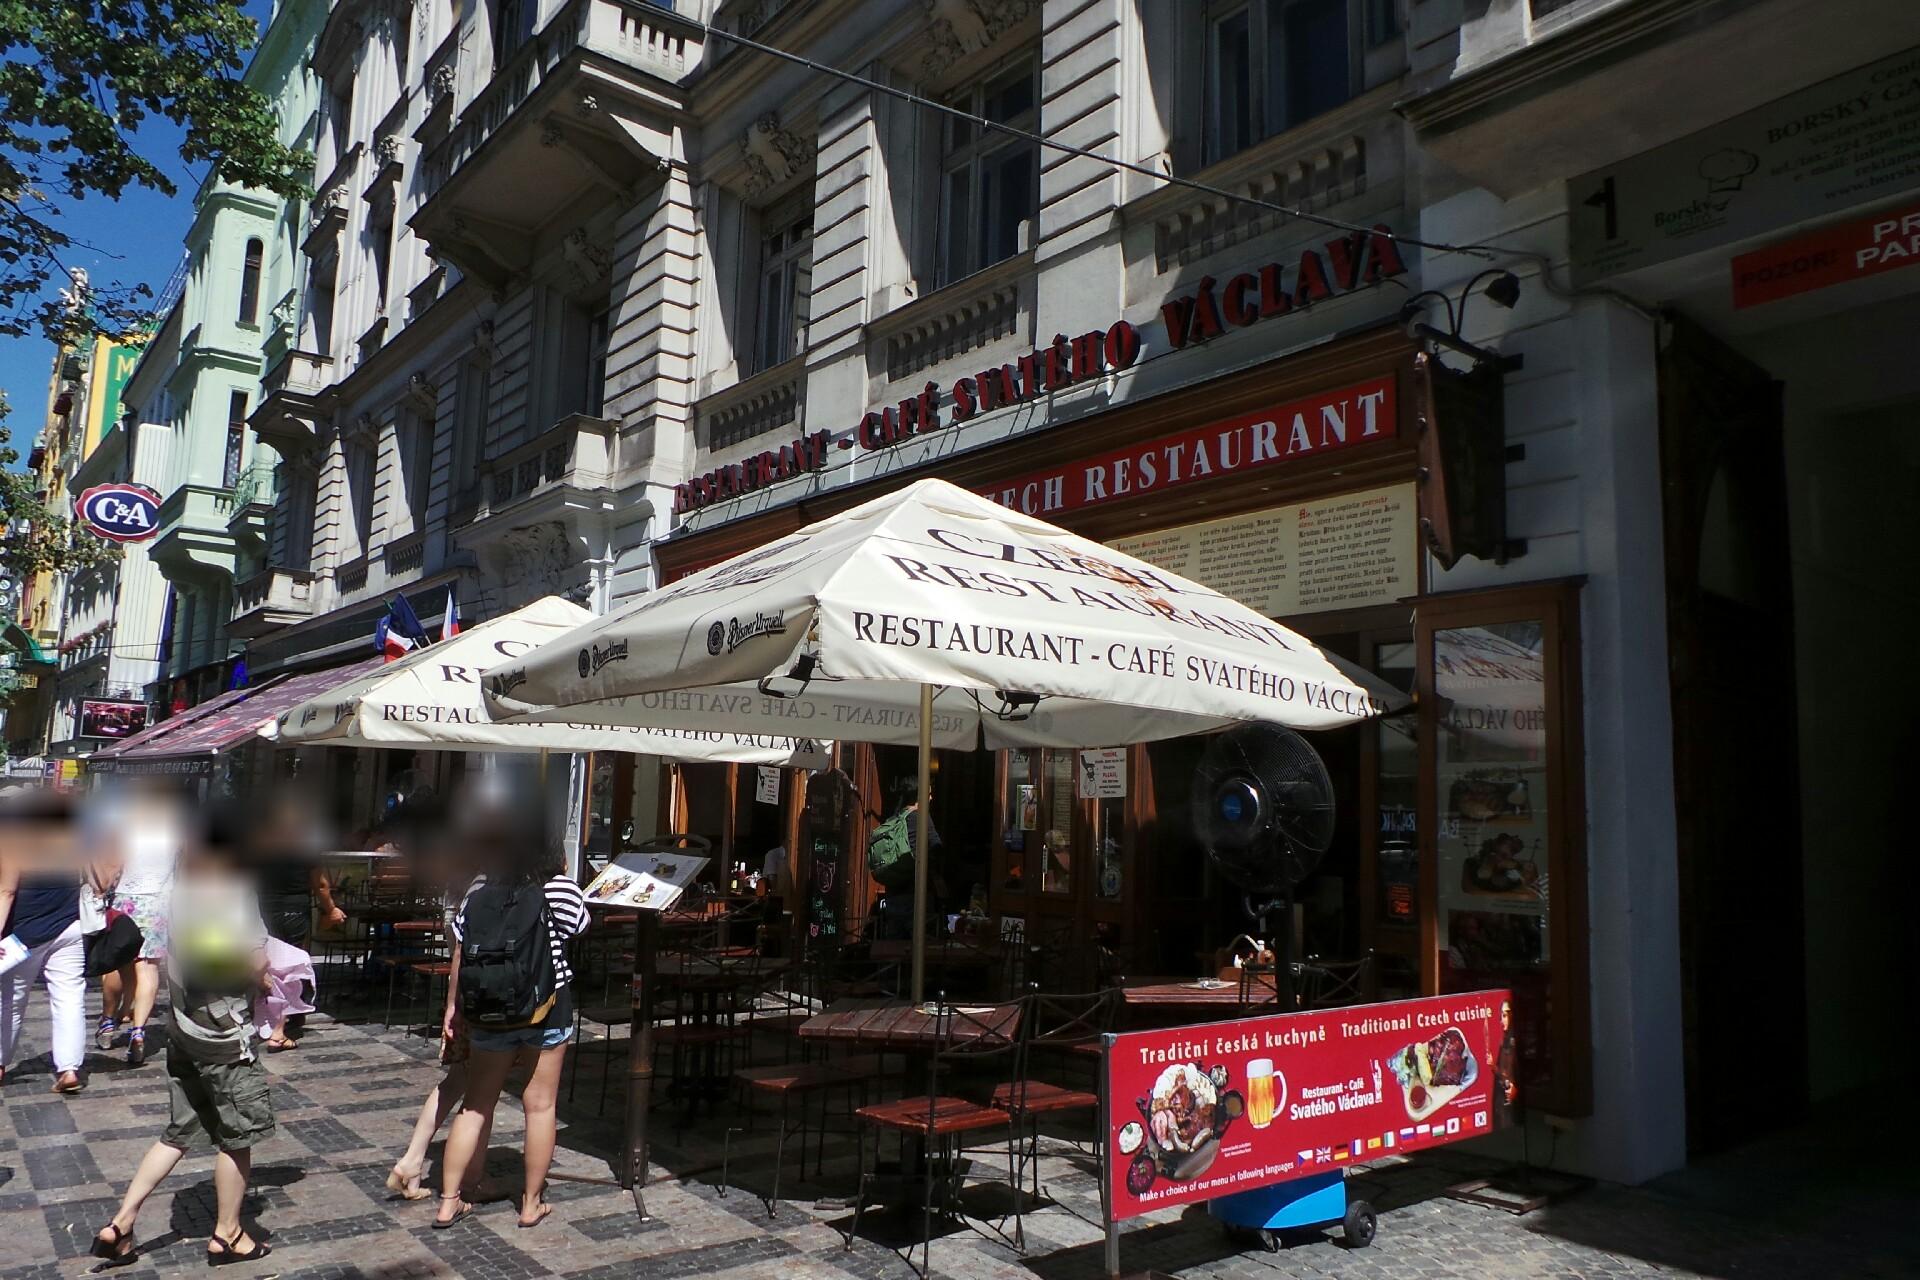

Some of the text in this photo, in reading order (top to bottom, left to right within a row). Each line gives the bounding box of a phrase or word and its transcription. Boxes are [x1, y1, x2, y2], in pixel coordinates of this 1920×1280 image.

[1582, 176, 1617, 241] 1
[671, 428, 831, 515] RESTAURANT
[859, 381, 940, 450] CAFÉ
[952, 319, 1140, 421] SVATÉHO
[1161, 223, 1408, 349] VÁCLAVA
[1084, 389, 1385, 502] RESTAURANT
[95, 497, 150, 528] C&A
[882, 554, 1296, 652] RESTAURANT
[853, 611, 1084, 665] RESTAURANT
[1107, 643, 1175, 677] CAFÉ
[1186, 656, 1295, 702] SVATÉHO
[1342, 1005, 1492, 1037] Traditional Czech cuisine
[1140, 1025, 1326, 1064] Tradiční česká kuchyně
[1290, 1091, 1374, 1120] Svatého Václava
[1302, 1083, 1343, 1099] Restaurant
[1349, 1078, 1364, 1091] Café
[1140, 1190, 1158, 1202] Make
[1166, 1183, 1188, 1196] choice
[1189, 1181, 1197, 1192] of
[1198, 1181, 1209, 1190] our
[1211, 1177, 1229, 1187] menu
[1230, 1174, 1236, 1183] in
[1237, 1166, 1264, 1182] following
[1265, 1161, 1294, 1175] languages
